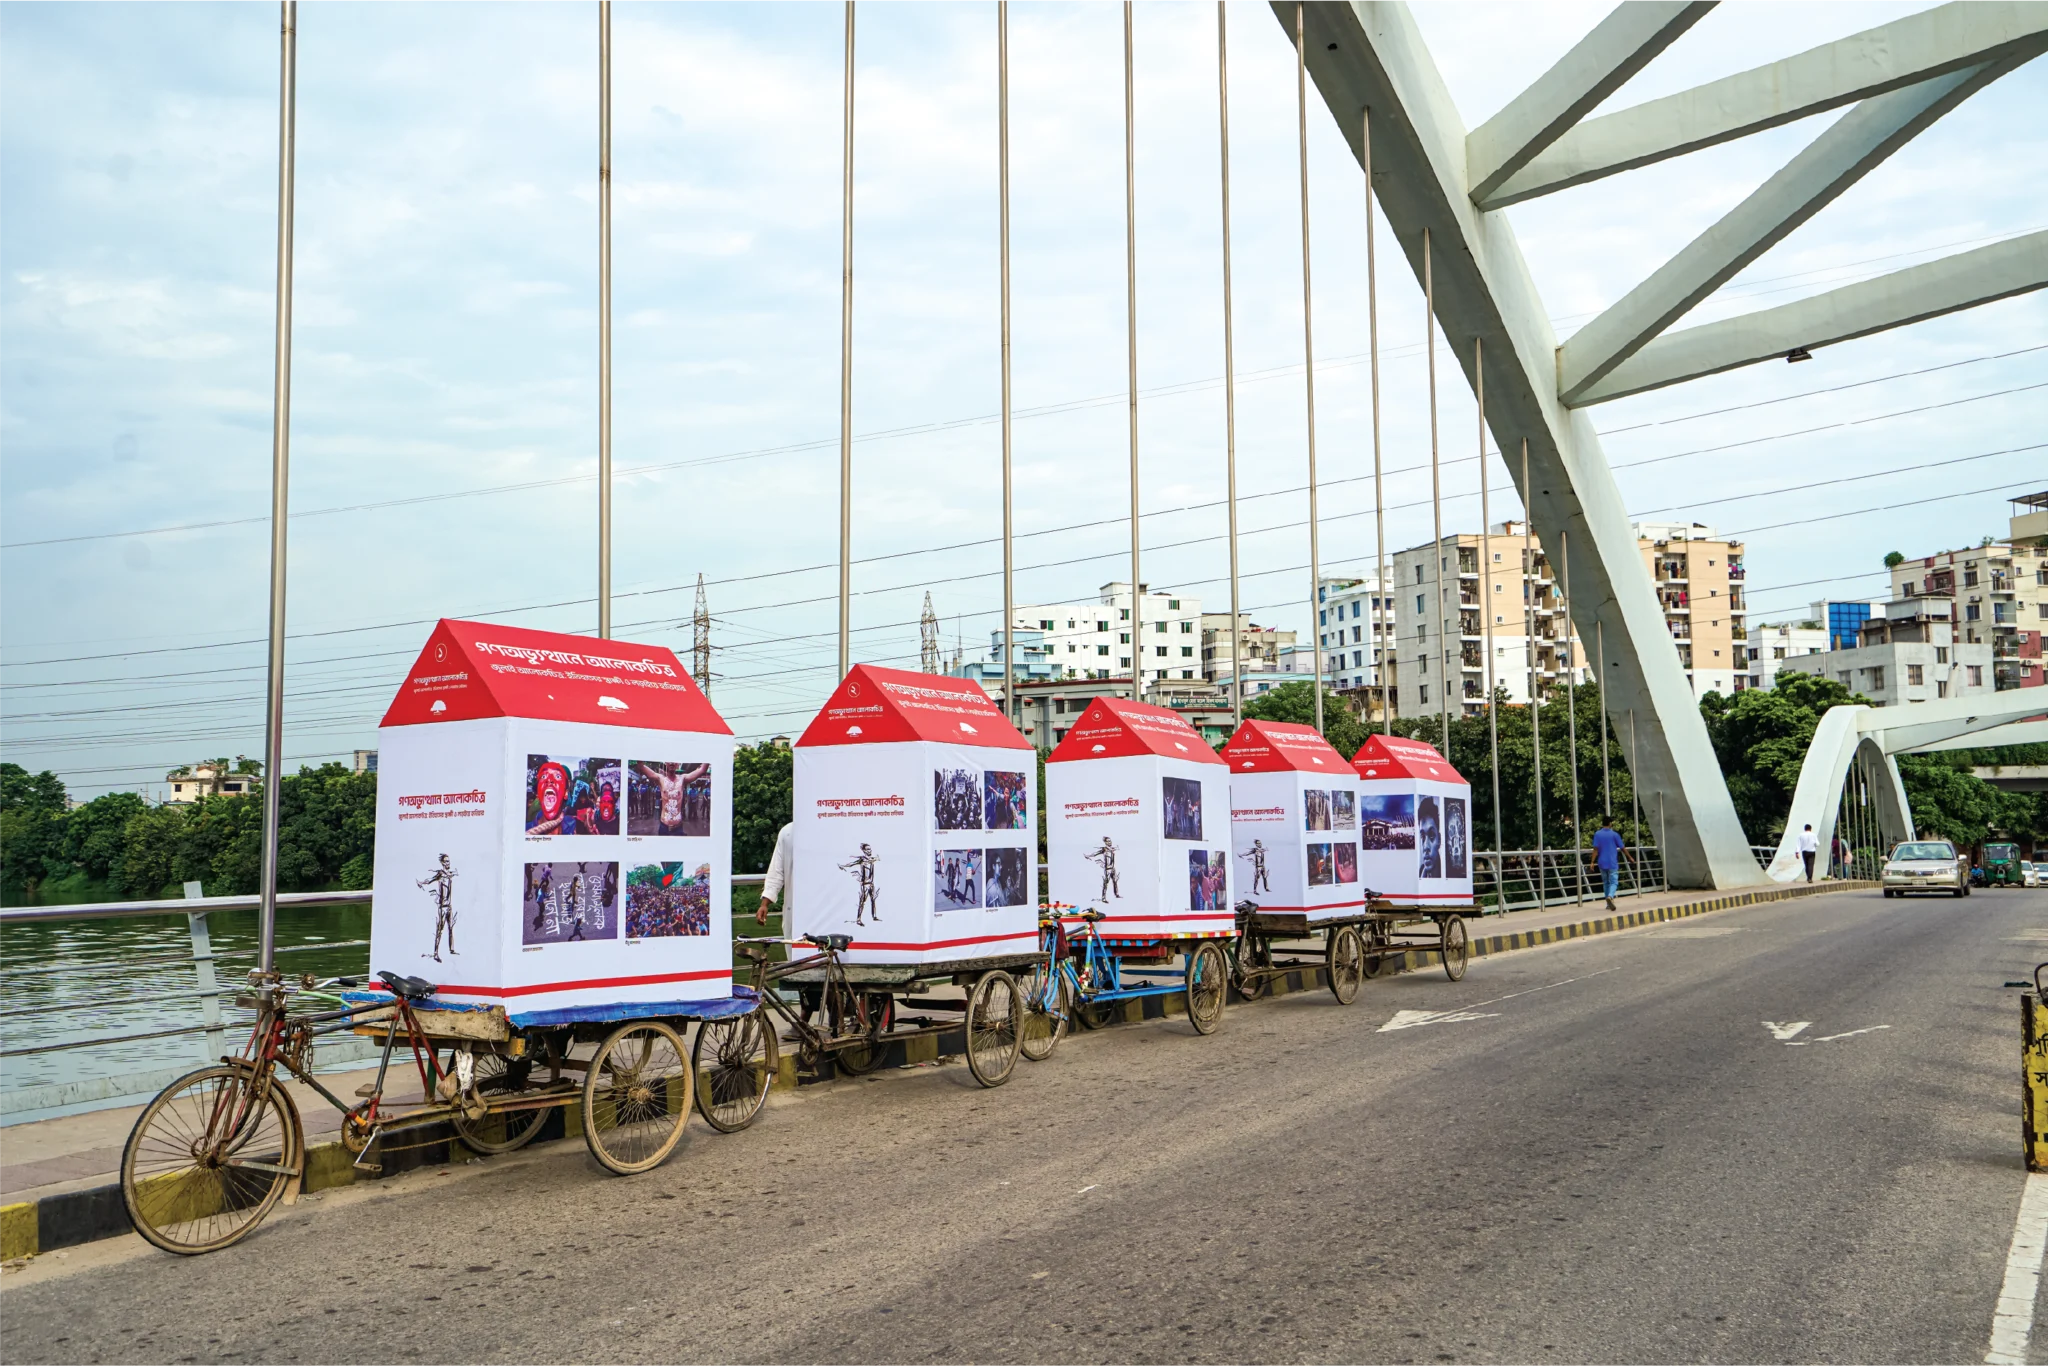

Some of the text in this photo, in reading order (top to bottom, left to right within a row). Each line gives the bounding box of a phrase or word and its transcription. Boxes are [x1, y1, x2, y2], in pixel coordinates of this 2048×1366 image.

[475, 641, 678, 678] গণঅভ্যুত্থানে আলোকচিত্র
[443, 789, 486, 804] আলোকচিত্র
[862, 794, 904, 807] আলোকচিত্র
[545, 917, 561, 935] না
